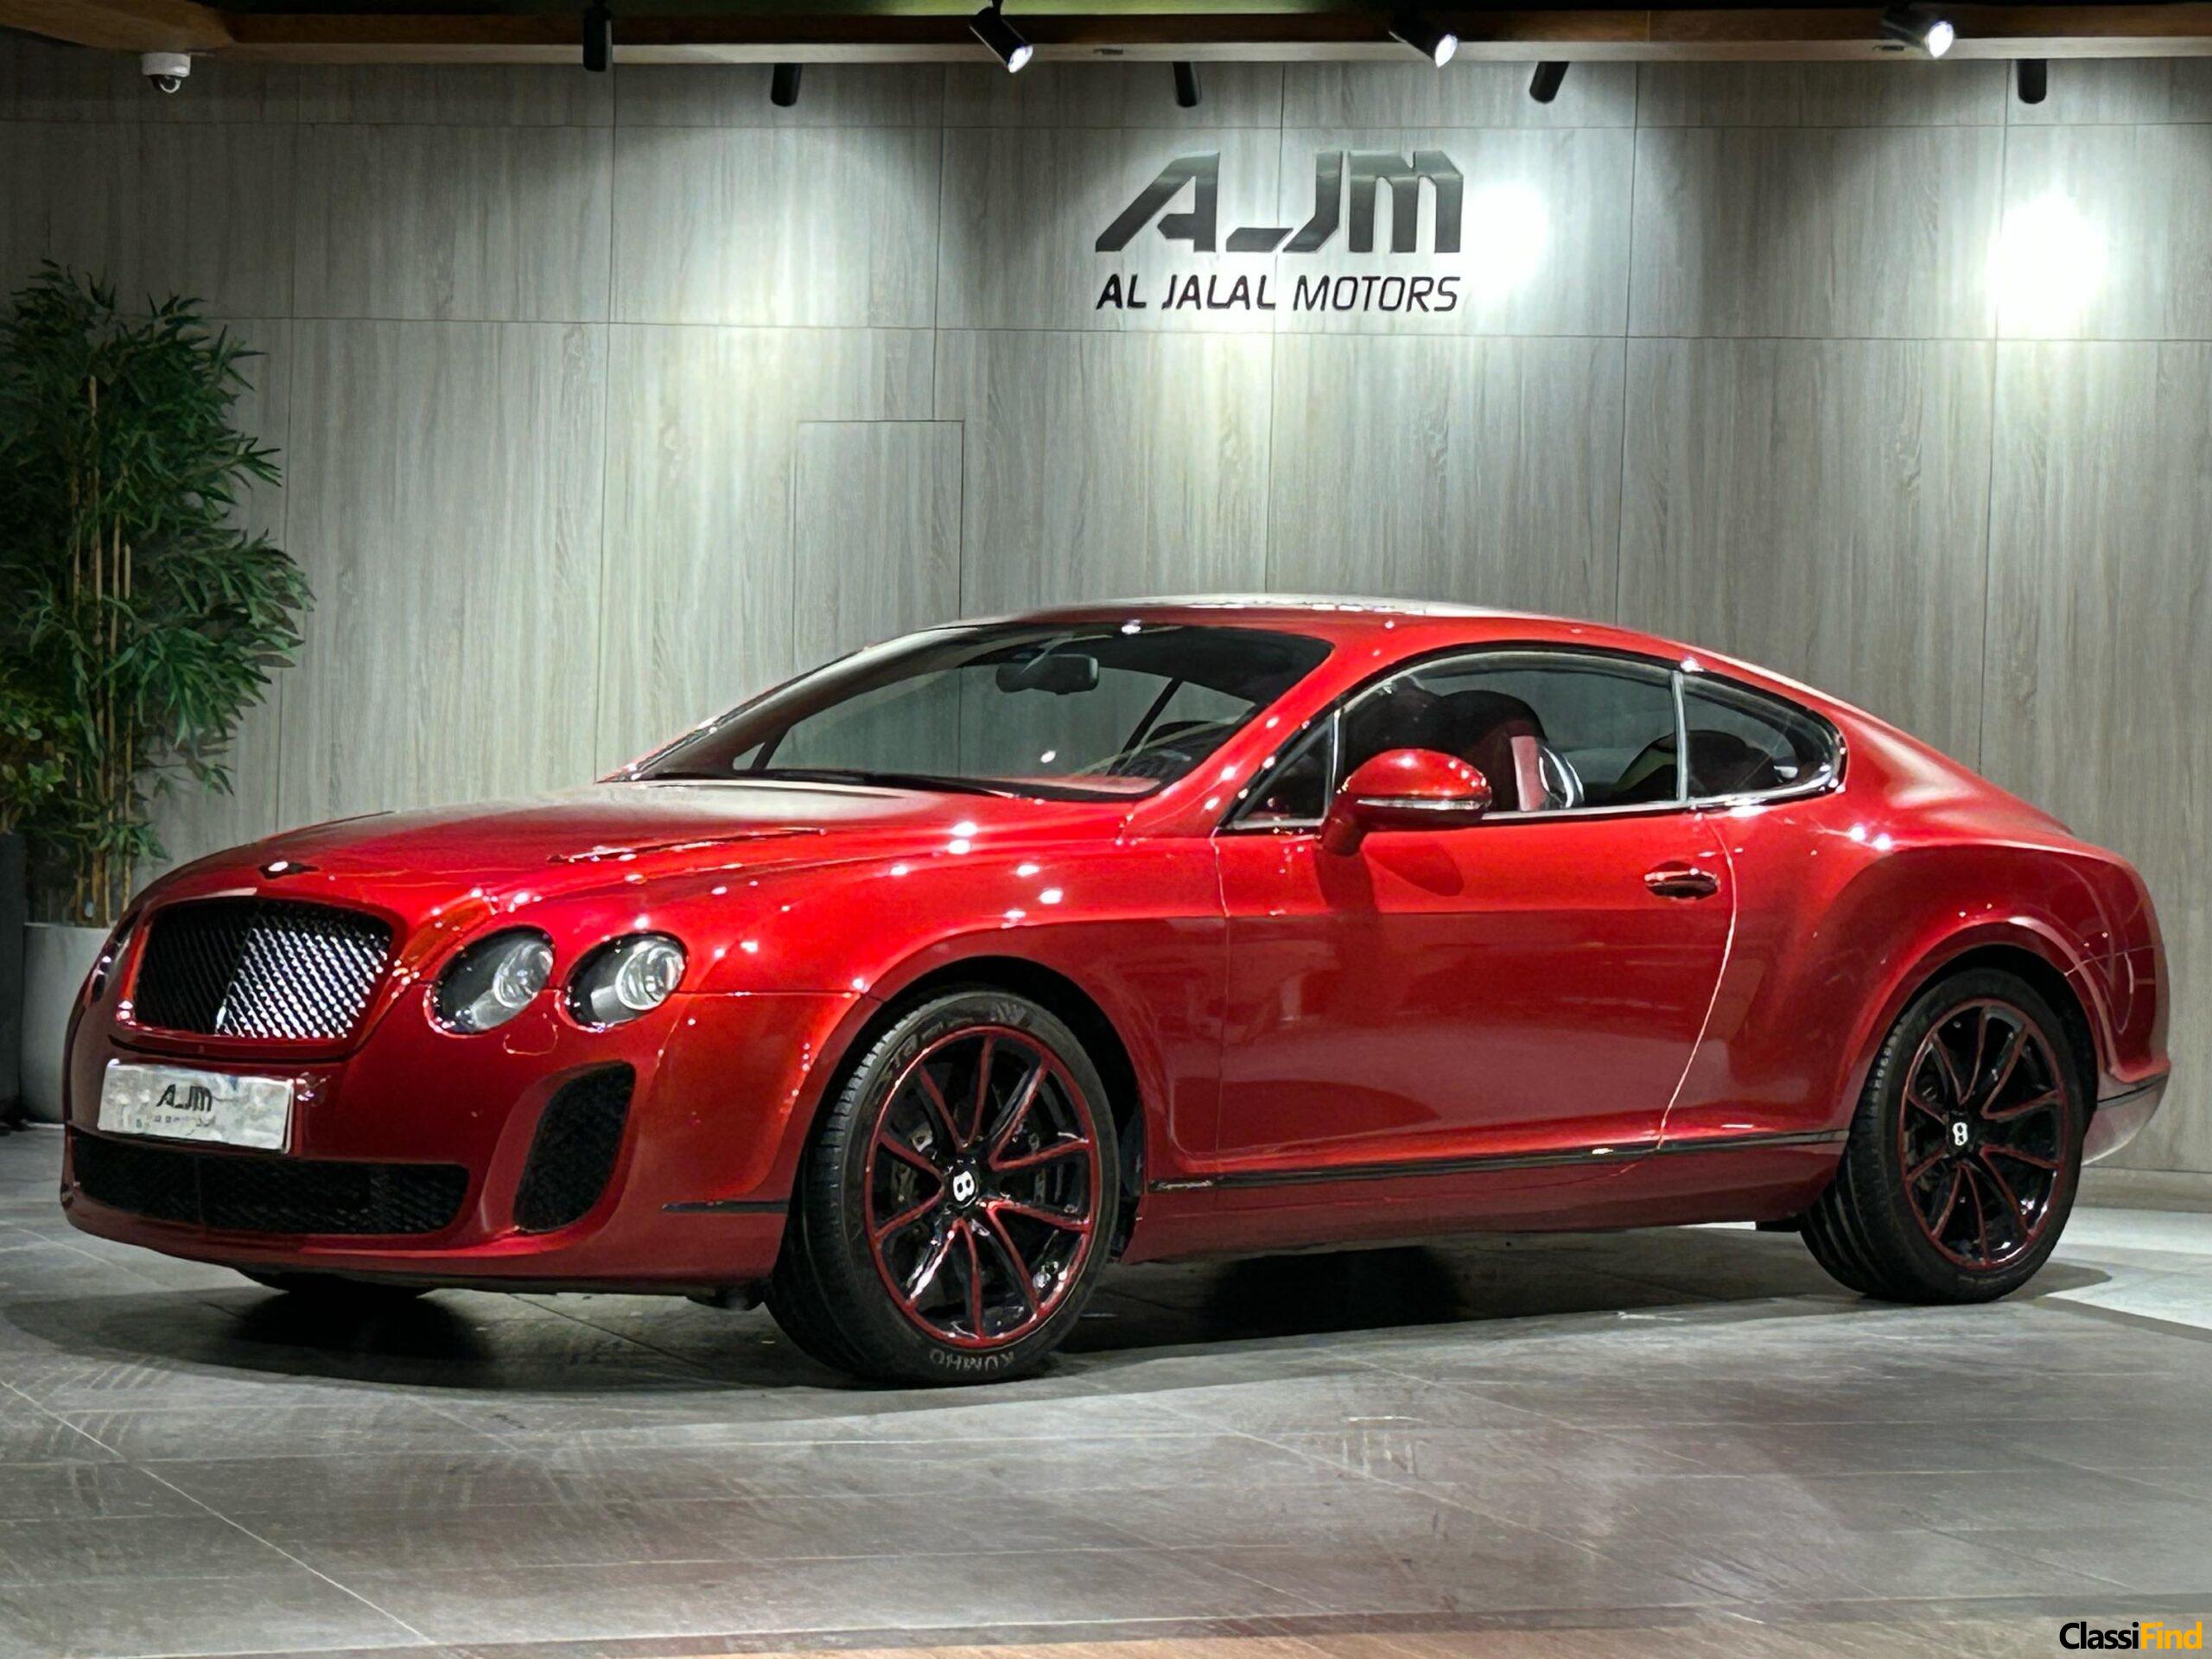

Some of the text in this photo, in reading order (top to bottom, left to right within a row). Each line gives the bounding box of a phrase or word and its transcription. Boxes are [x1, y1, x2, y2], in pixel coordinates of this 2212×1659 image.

[1096, 273, 1461, 312] AL JALAL MOTORS
[930, 1349, 1014, 1371] KUMHO
